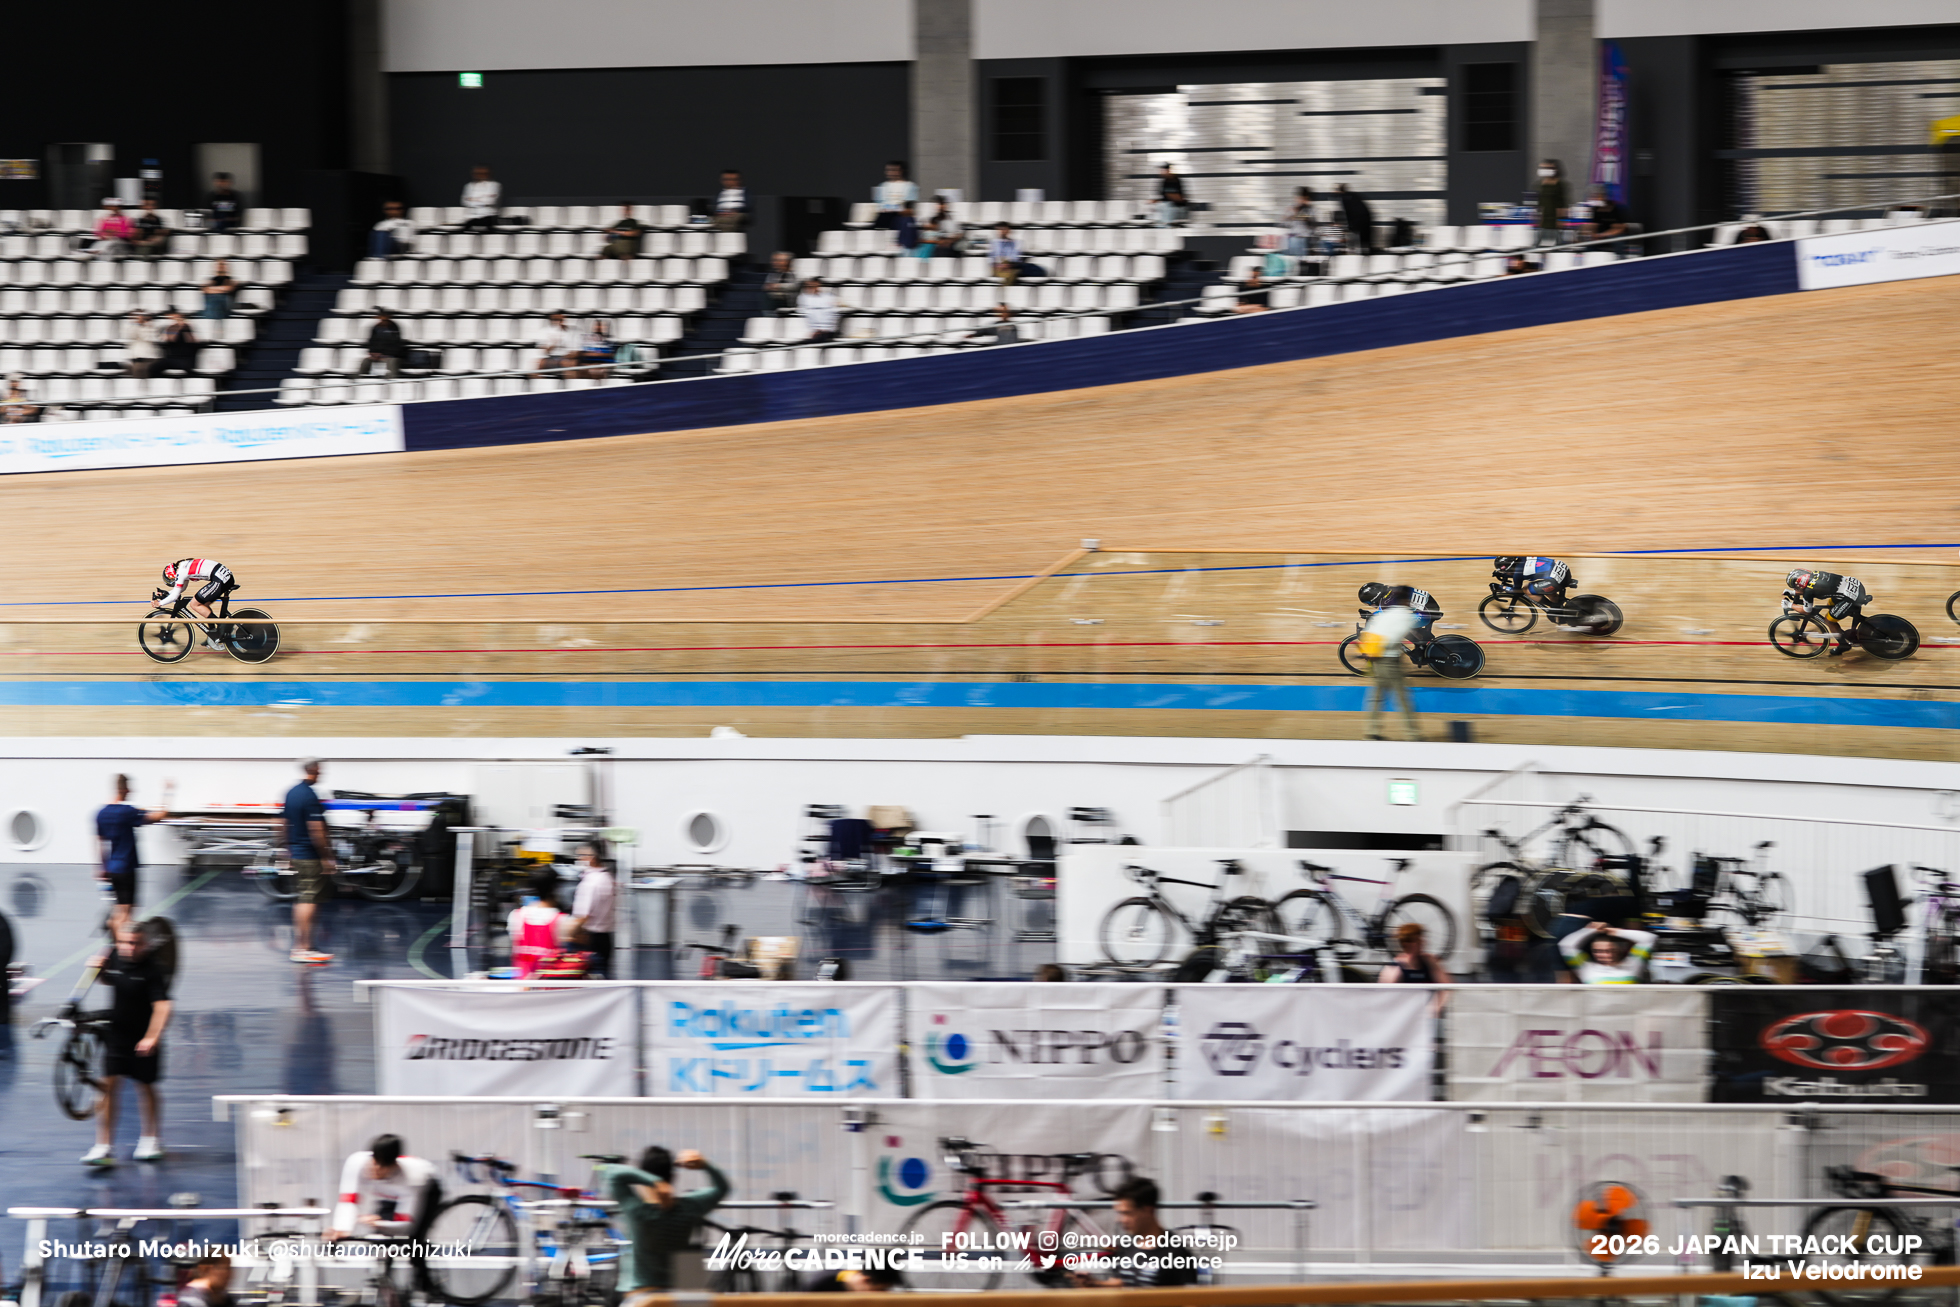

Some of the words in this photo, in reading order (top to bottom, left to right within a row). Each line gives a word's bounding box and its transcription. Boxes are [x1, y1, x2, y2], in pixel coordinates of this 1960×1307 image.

[667, 1001, 850, 1038] Rakuten
[987, 1029, 1149, 1065] NIPPO
[1270, 1039, 1408, 1075] Cyclers
